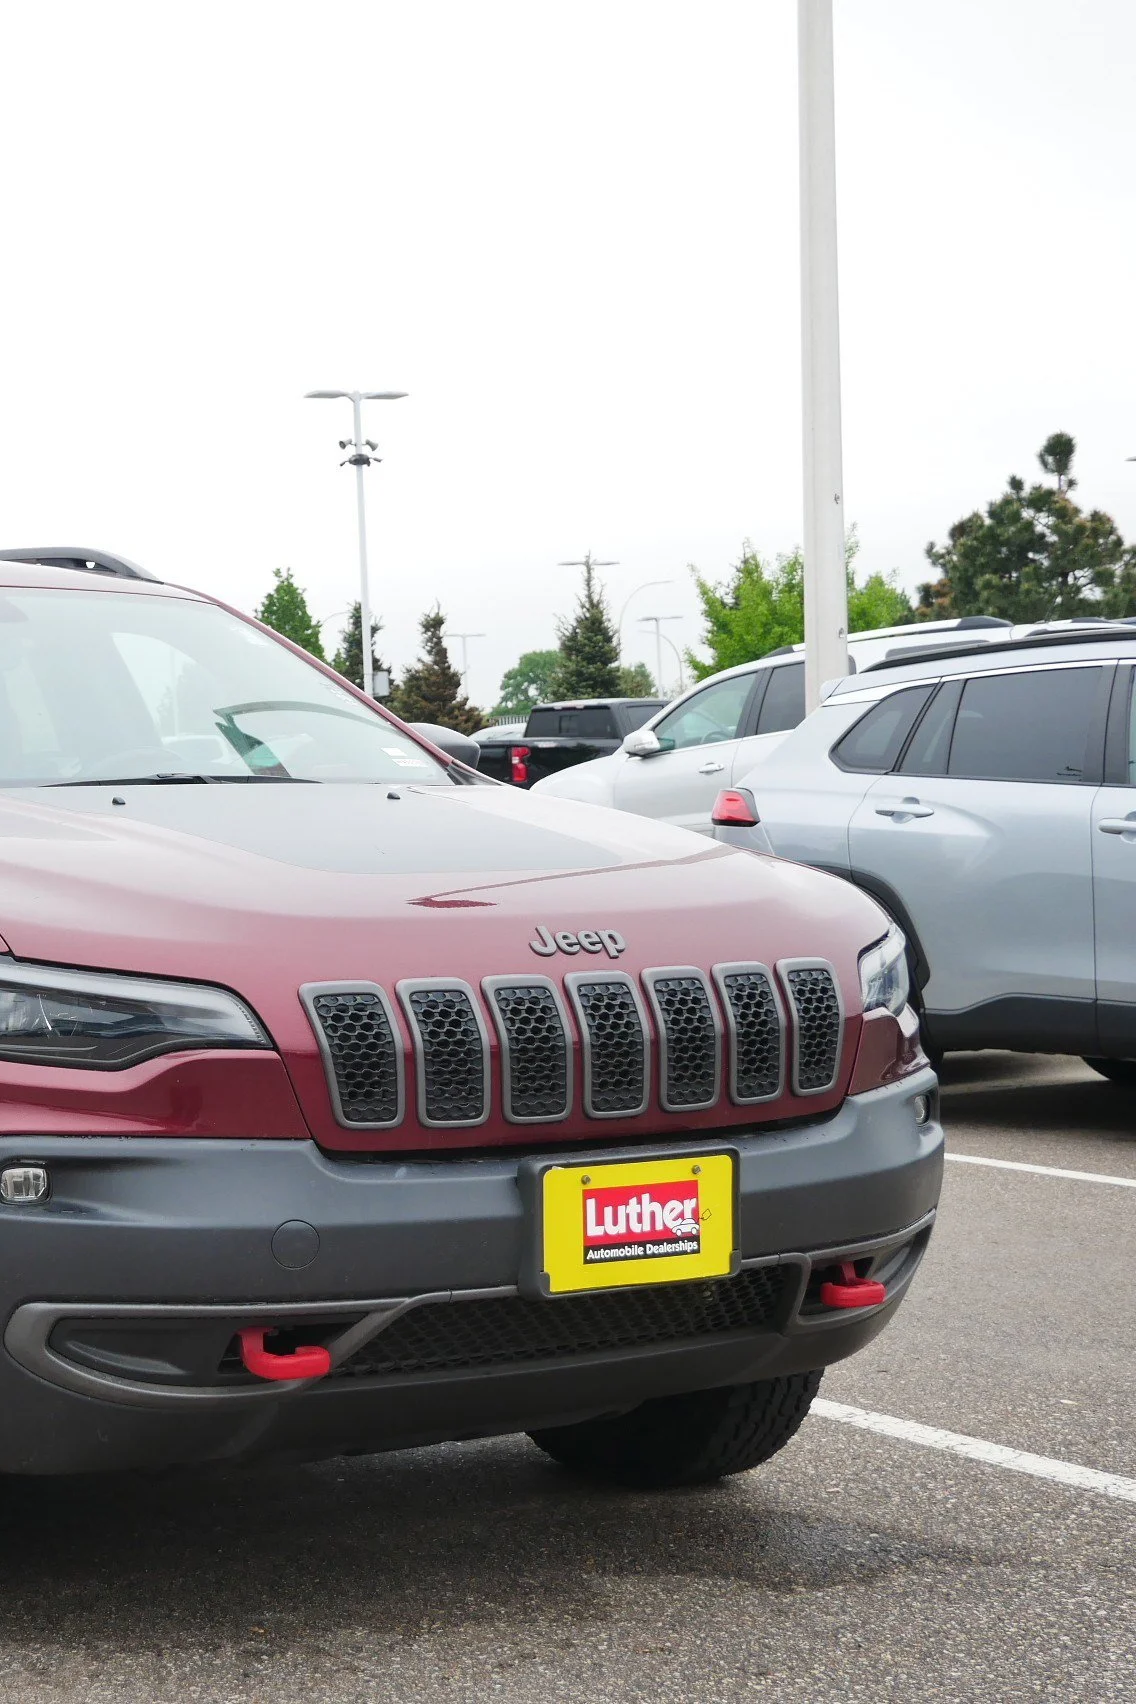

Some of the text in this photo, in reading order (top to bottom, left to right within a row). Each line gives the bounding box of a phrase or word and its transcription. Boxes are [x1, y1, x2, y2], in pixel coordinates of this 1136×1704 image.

[528, 925, 627, 959] Jeep
[585, 1192, 697, 1237] Luther
[586, 1239, 698, 1260] Automobile Dealerships
